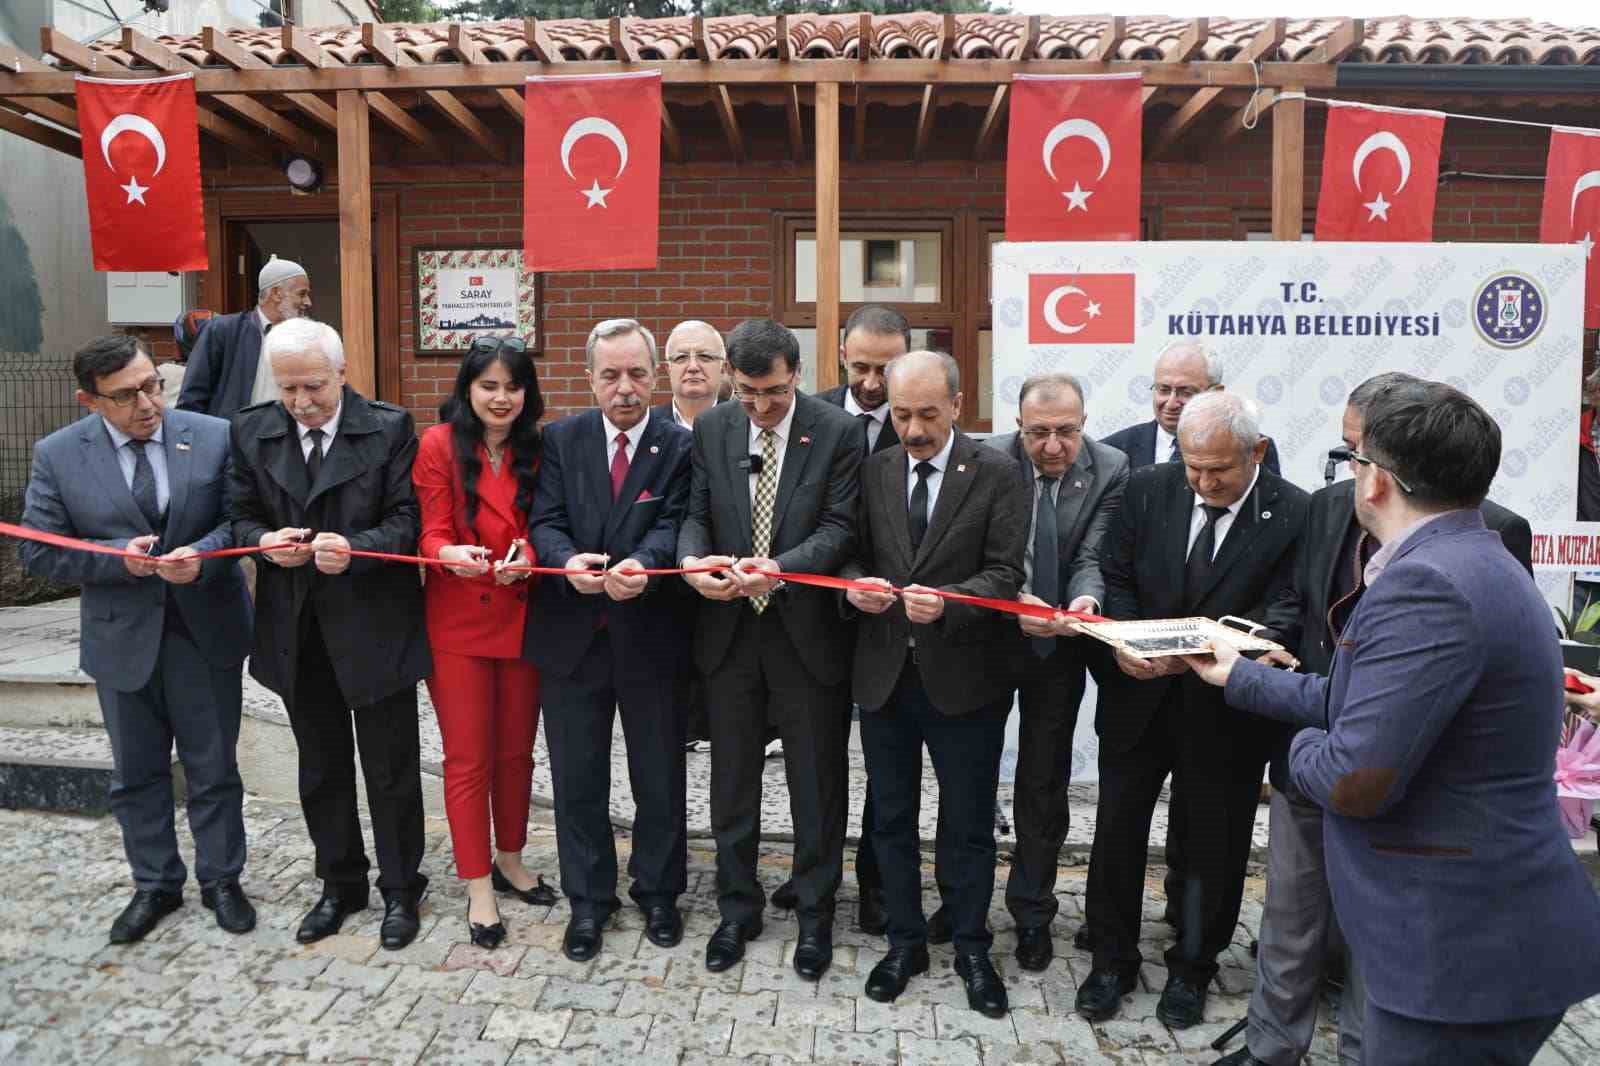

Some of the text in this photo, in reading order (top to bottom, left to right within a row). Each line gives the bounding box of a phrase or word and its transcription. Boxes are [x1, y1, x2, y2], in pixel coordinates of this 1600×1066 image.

[460, 289, 492, 299] SARAY
[1280, 281, 1323, 303] T.C.
[1168, 311, 1440, 336] KÜTAHYA BELEDİYESİ
